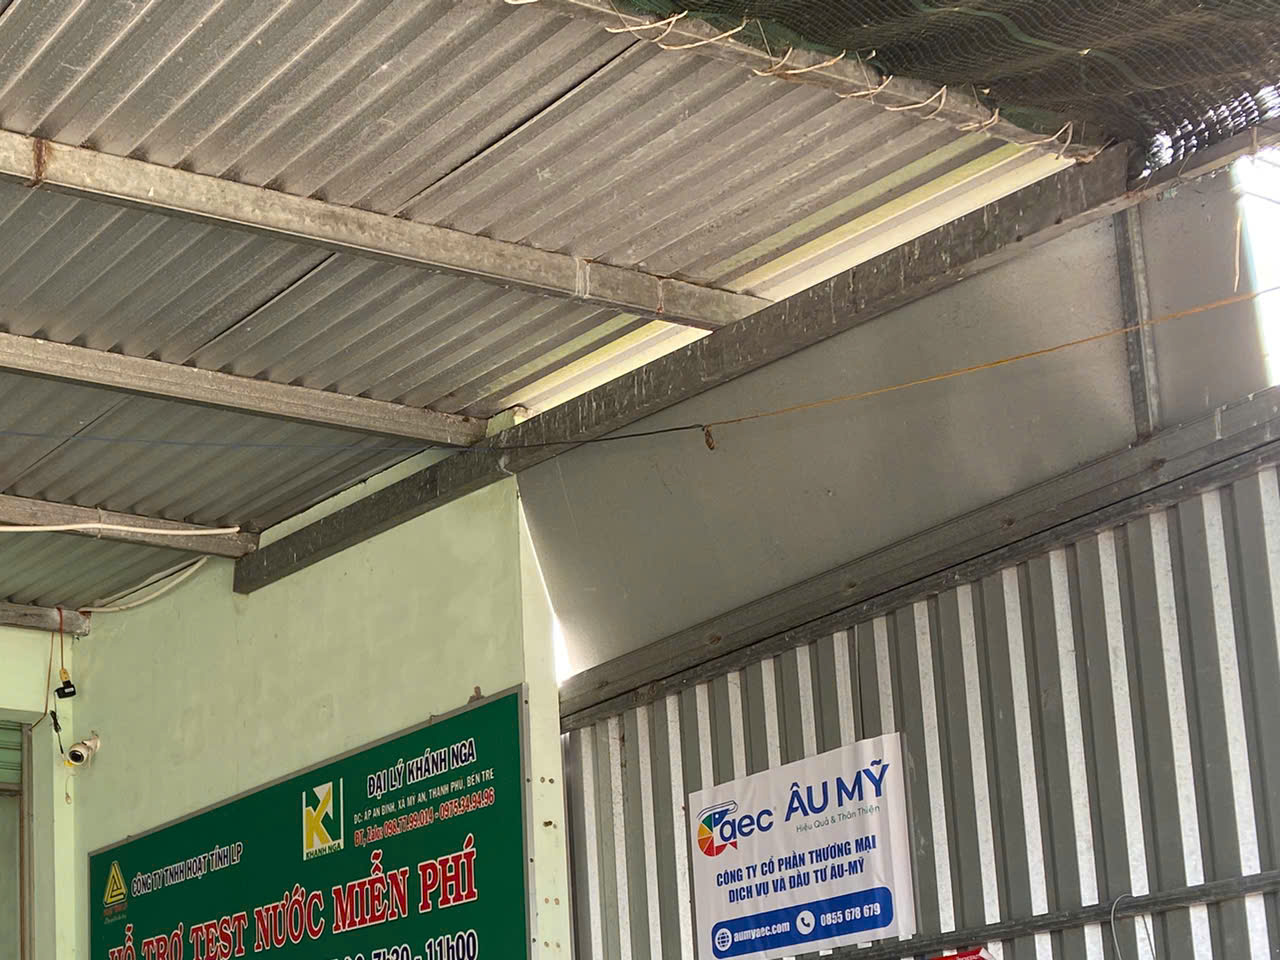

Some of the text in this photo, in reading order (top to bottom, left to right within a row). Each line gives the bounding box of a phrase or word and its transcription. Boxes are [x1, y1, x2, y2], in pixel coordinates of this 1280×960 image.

[367, 737, 477, 799] ĐẠI LÝ KHÁNH NGA
[482, 768, 495, 783] TRE
[785, 758, 890, 822] ÂU MỸ
[720, 809, 773, 842] aec
[796, 821, 813, 833] Hiệu
[814, 817, 830, 831] Quả
[131, 872, 151, 897] CÔNG
[164, 862, 185, 886] TNHH
[716, 834, 877, 887] CÔNG TY CỔ PHẦN THƯƠNG MẠI
[728, 857, 865, 906] DỊCH VỤ VÀ ĐẦU TƯ ÂU-MỸ
[254, 883, 324, 952] NƯỚC
[332, 849, 409, 934] MIỄN
[418, 833, 478, 913] PHÍ
[733, 902, 881, 943] aumyaec.com 0855 678 679
